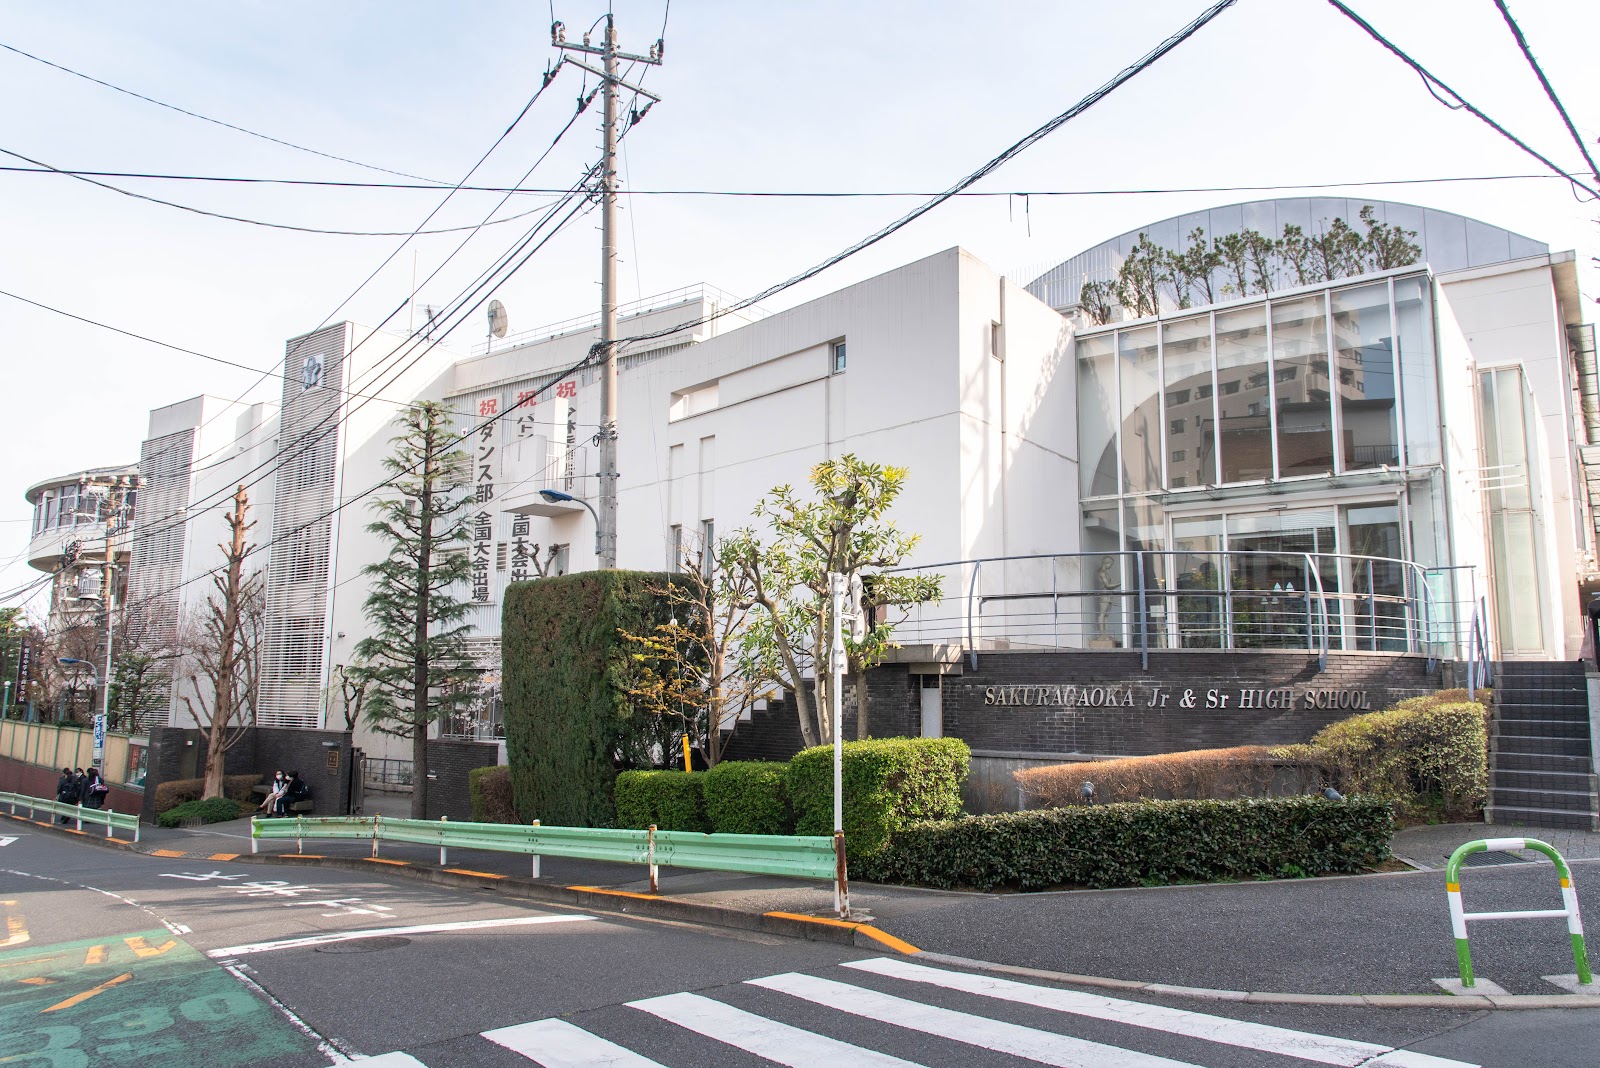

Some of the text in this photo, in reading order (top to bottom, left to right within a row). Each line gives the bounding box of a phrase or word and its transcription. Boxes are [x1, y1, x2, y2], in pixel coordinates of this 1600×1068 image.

[517, 390, 536, 408] 祝
[557, 380, 577, 398] 祝
[472, 399, 497, 601] 祝 ダンス部 全国大会出場
[984, 687, 1371, 710] SAKURAGAOKA Jr & Sr HIGH SCHOOL
